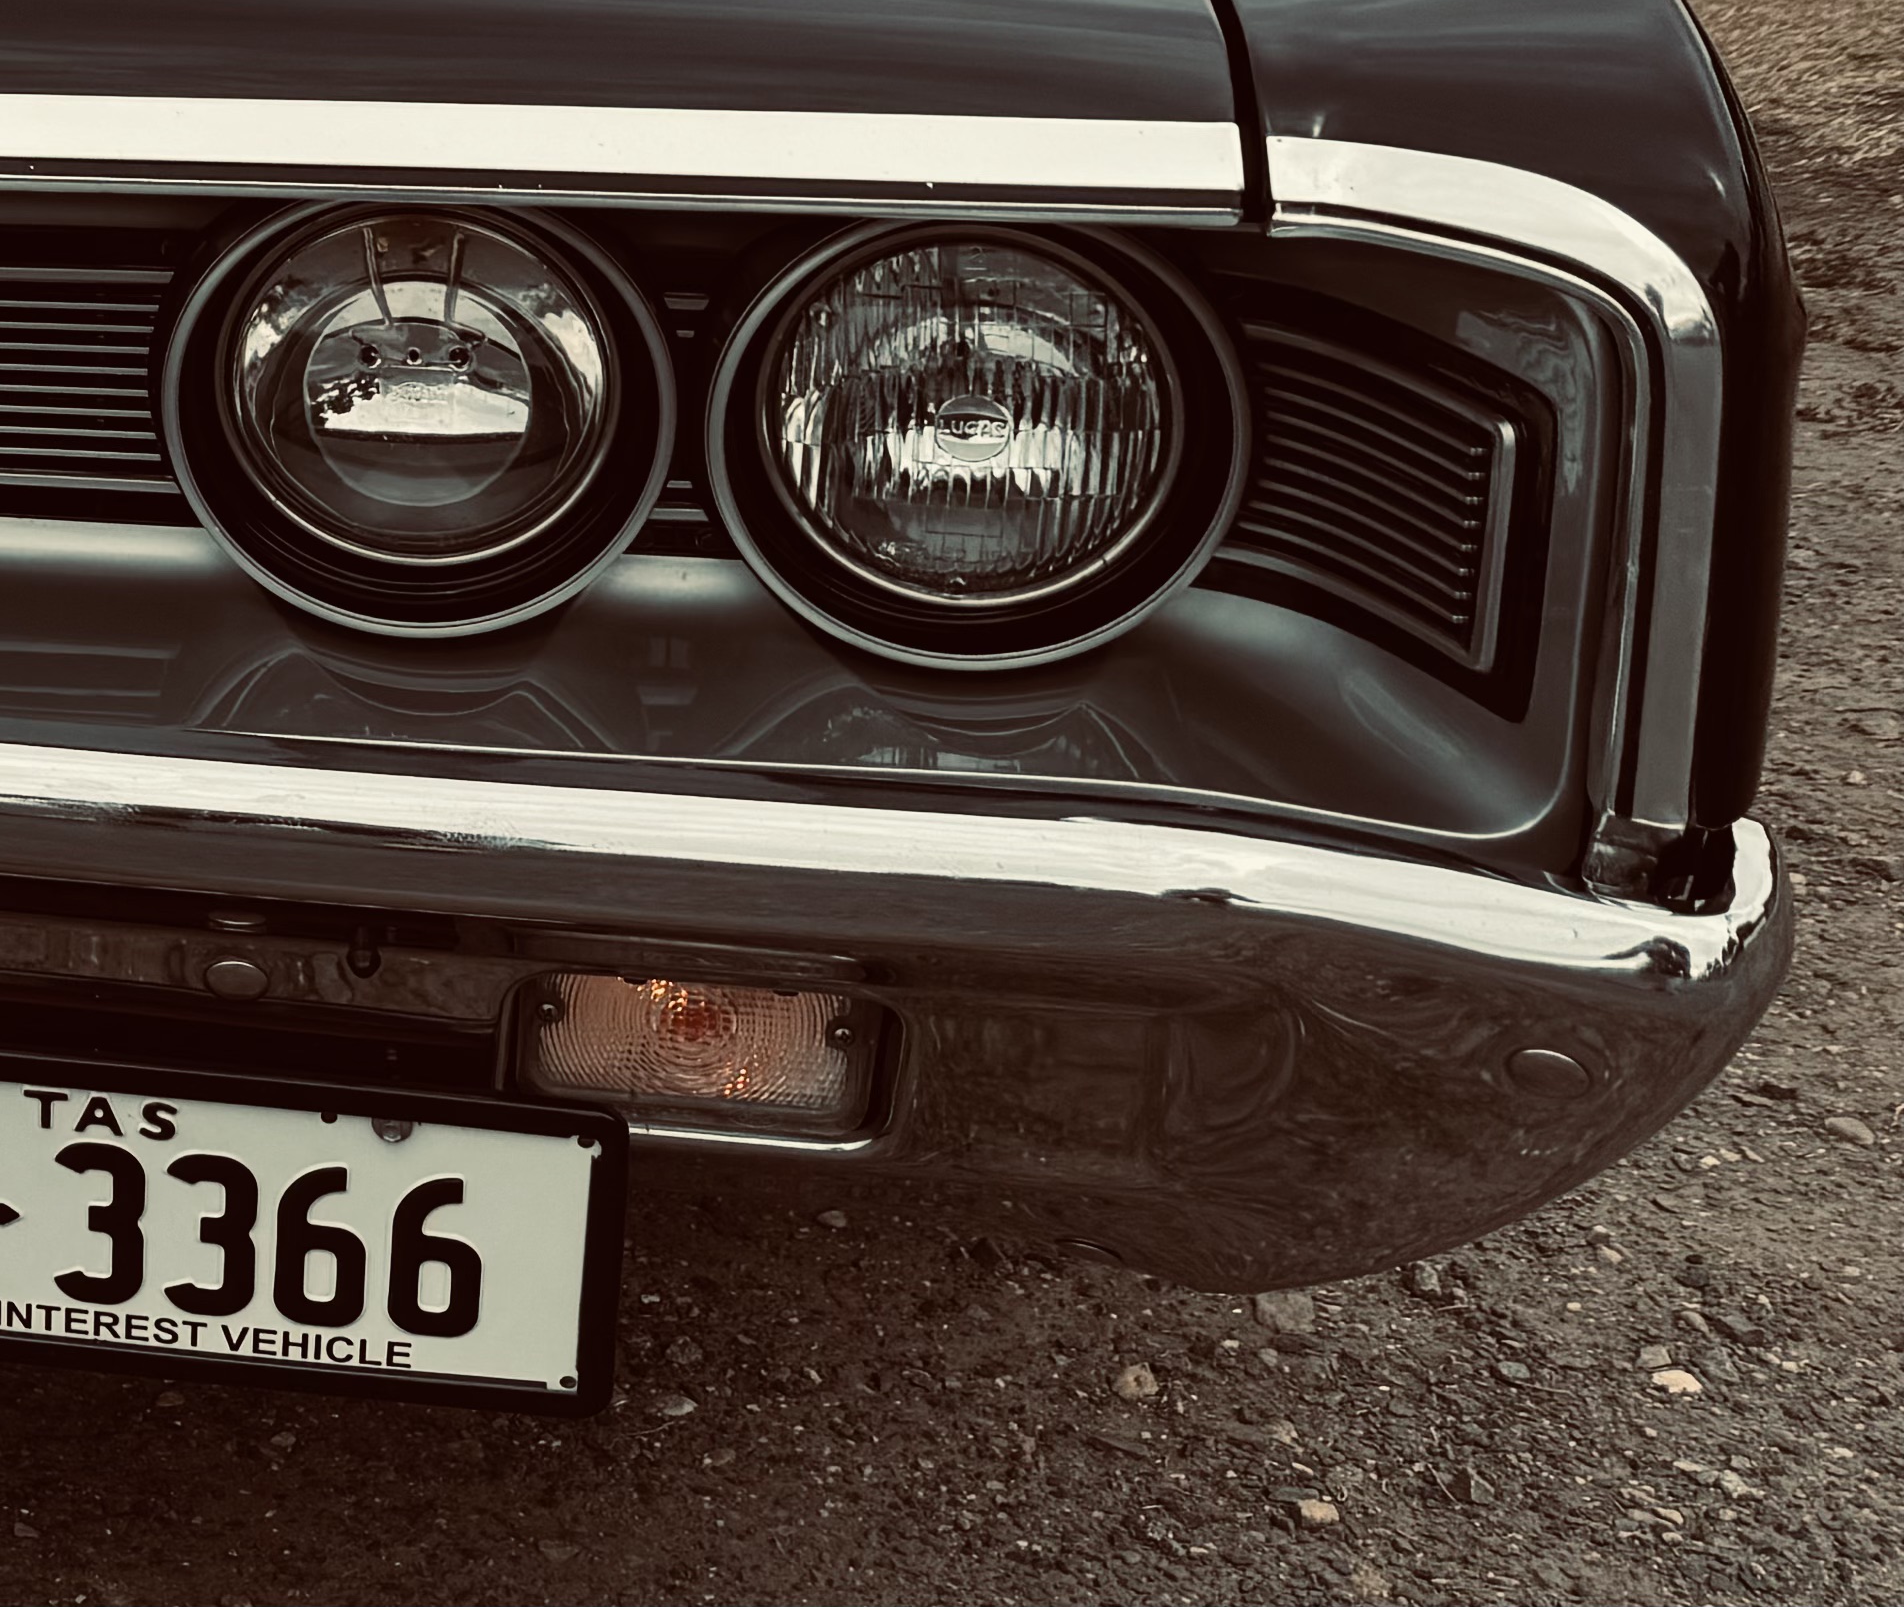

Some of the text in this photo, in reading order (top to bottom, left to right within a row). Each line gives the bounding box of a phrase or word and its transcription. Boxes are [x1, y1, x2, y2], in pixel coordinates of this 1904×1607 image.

[937, 419, 1008, 438] LUCAS
[23, 1089, 179, 1140] TAS
[220, 1324, 413, 1369] VEHICLE
